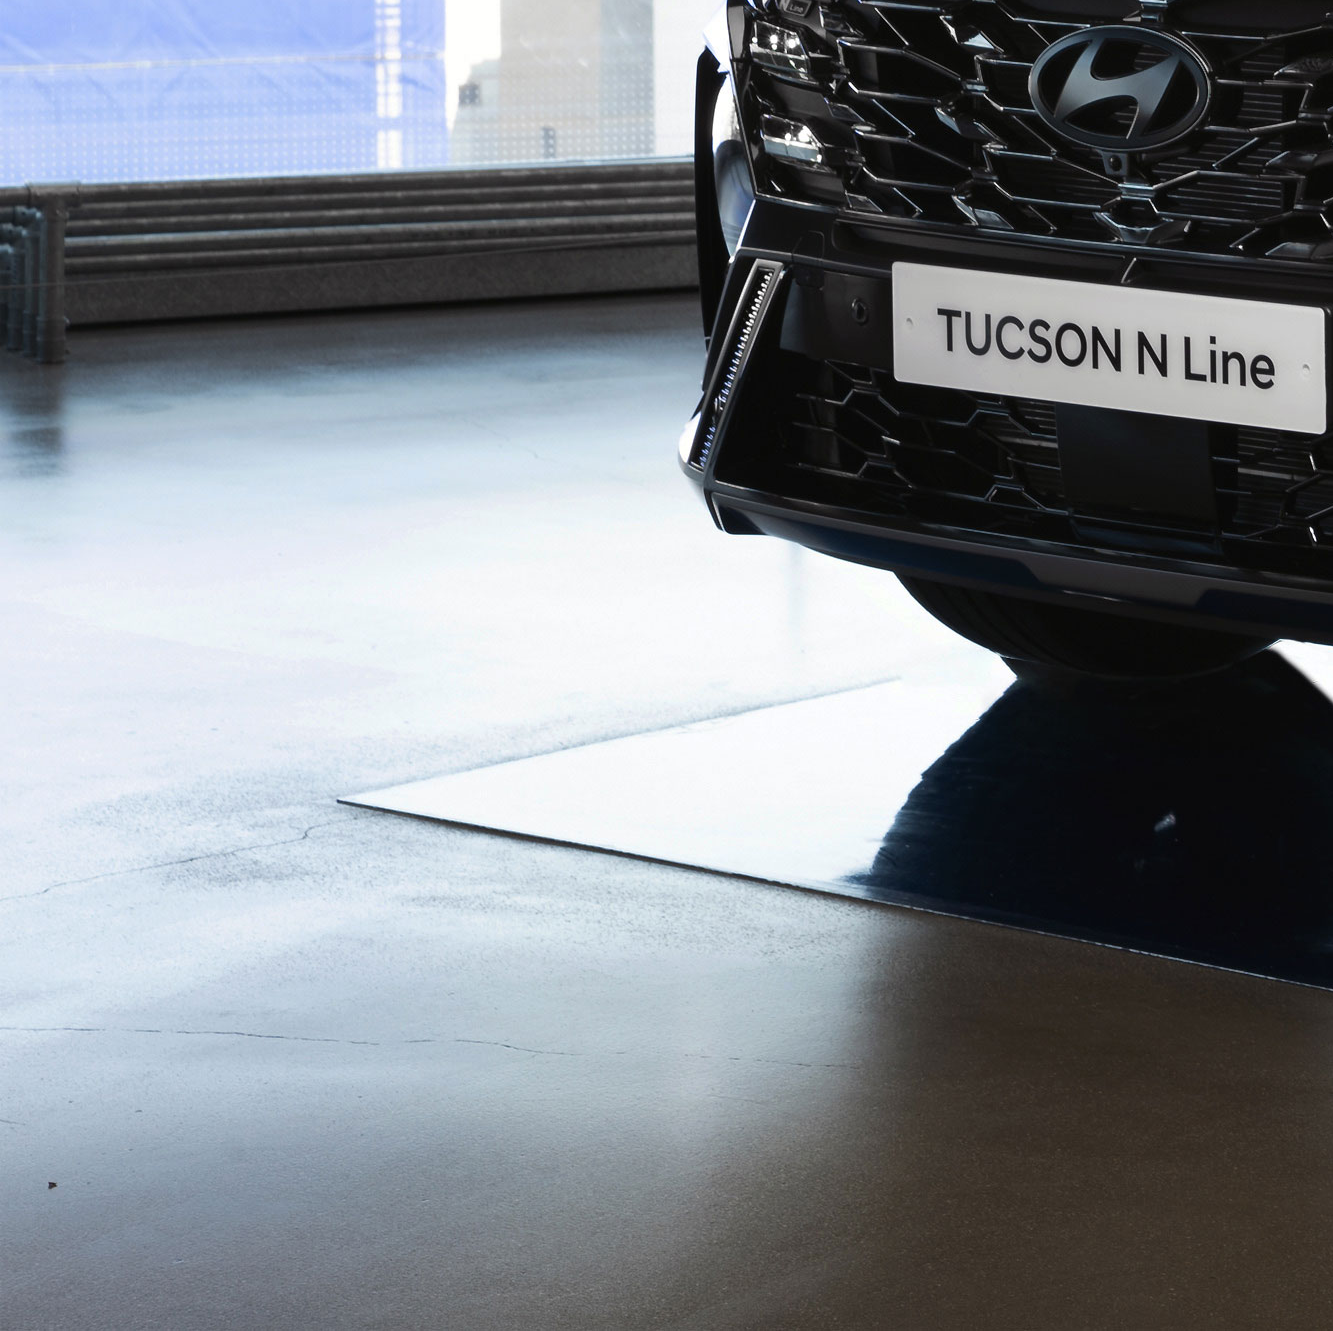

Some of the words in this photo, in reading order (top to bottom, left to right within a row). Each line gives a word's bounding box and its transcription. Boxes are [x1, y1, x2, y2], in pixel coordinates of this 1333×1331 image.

[936, 307, 1122, 372] TUCSON
[1137, 330, 1168, 378] N
[1183, 334, 1276, 390] Line
